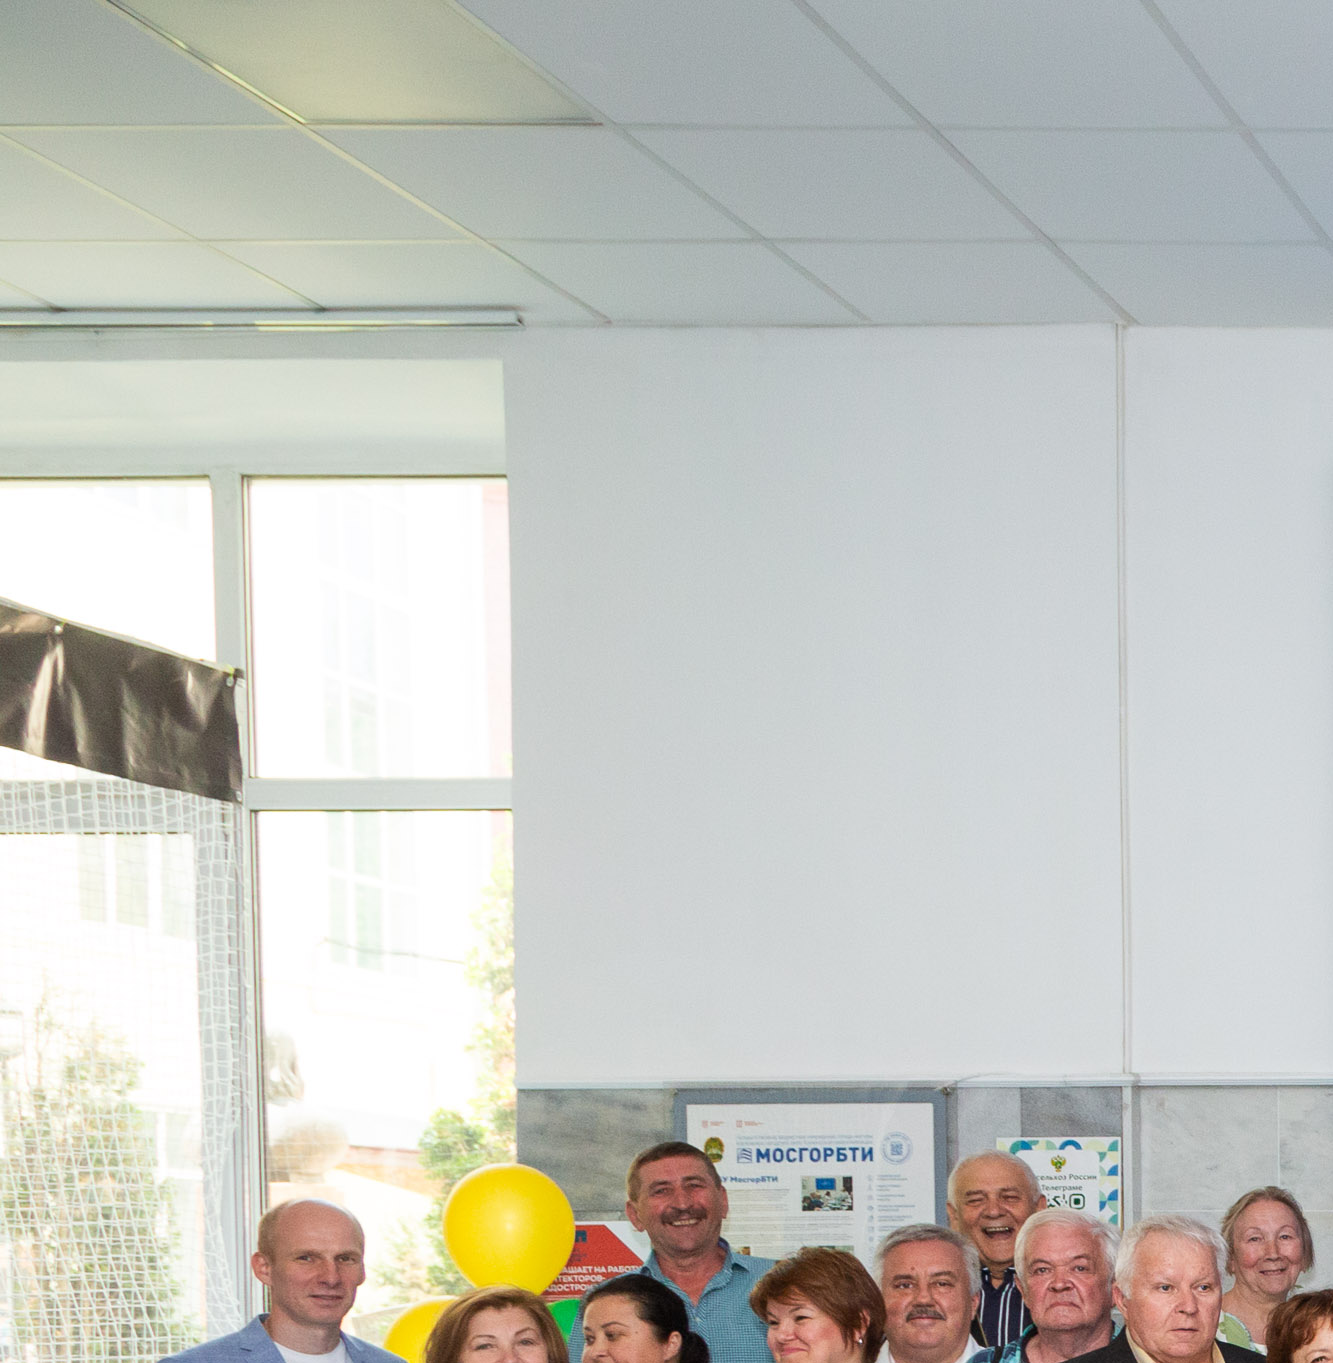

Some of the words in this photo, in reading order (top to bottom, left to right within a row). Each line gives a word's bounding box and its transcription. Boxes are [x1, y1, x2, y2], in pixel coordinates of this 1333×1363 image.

[756, 1147, 874, 1163] МОСГОРБТИ
[1069, 1172, 1097, 1181] России
[562, 1265, 592, 1274] АШАЕТ
[594, 1265, 606, 1274] НА
